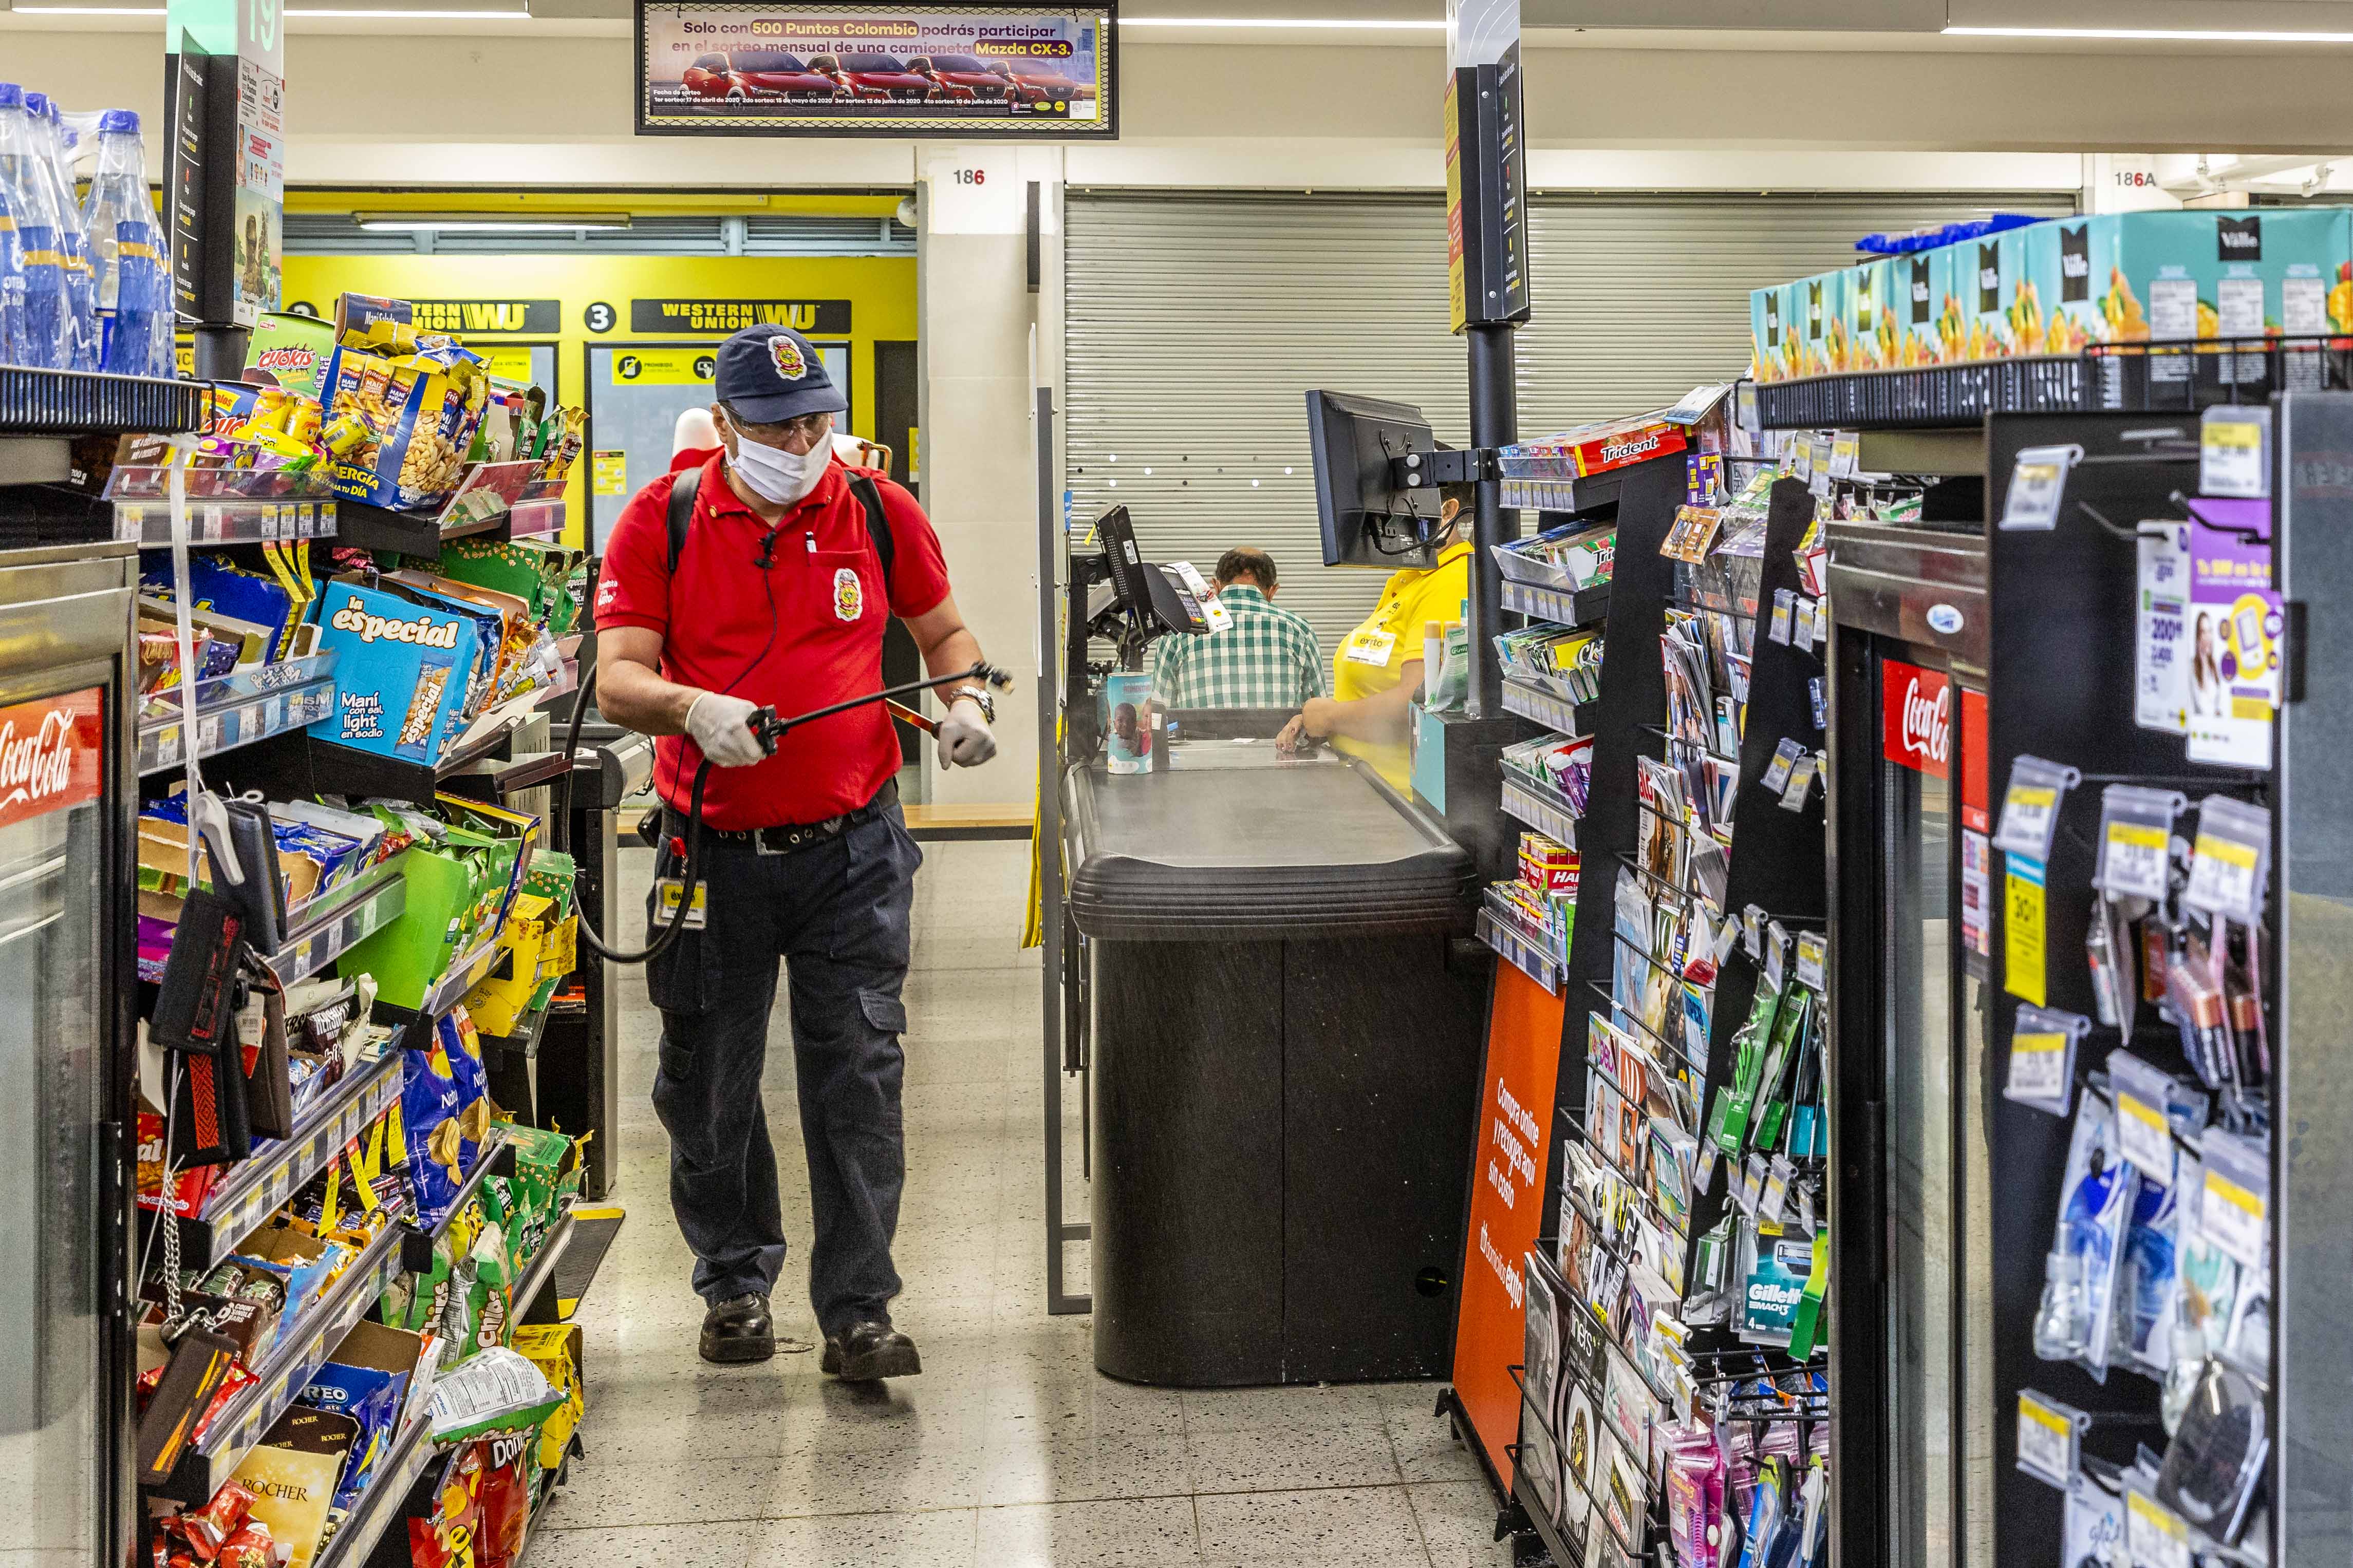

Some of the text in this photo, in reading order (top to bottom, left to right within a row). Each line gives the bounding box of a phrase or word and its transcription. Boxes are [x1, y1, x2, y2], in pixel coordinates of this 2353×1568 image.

[684, 22, 1056, 39] Solo con 500 Puntos Colombia podrás participar
[672, 41, 1071, 55] en el sorteo mensual de una camioneta Mazda CX-3.
[954, 169, 985, 185] 186
[2115, 172, 2156, 186] 186A
[469, 304, 525, 330] WU
[590, 305, 609, 330] 3
[662, 304, 753, 316] WESTERN
[691, 317, 753, 329] UNION
[257, 350, 316, 370] CHOKIS
[389, 389, 405, 398] MANÍ
[1601, 436, 1658, 463] Trident
[350, 485, 367, 498] DÍA
[348, 596, 364, 610] la
[332, 609, 459, 649] especial
[341, 692, 379, 708] Maní
[368, 706, 384, 714] sal,
[404, 681, 443, 744] especial
[344, 714, 377, 732] light
[341, 729, 383, 740] en sodio
[1622, 1055, 1640, 1111] AD
[1498, 1077, 1539, 1149] Compra online
[1493, 1117, 1537, 1187] y recoges aquí
[1489, 1158, 1515, 1210] sin costo
[1505, 1258, 1523, 1310] éxito
[235, 1303, 256, 1312] COUNT
[1755, 1302, 1789, 1316] MACH3
[476, 1289, 507, 1349] Chips
[1748, 1317, 1754, 1329] 4
[304, 1386, 347, 1403] REO
[436, 1393, 448, 1415] PEPSICO
[292, 1415, 318, 1426] ROCHER
[321, 1433, 346, 1442] ROCHER
[242, 1479, 308, 1502] ROCHER
